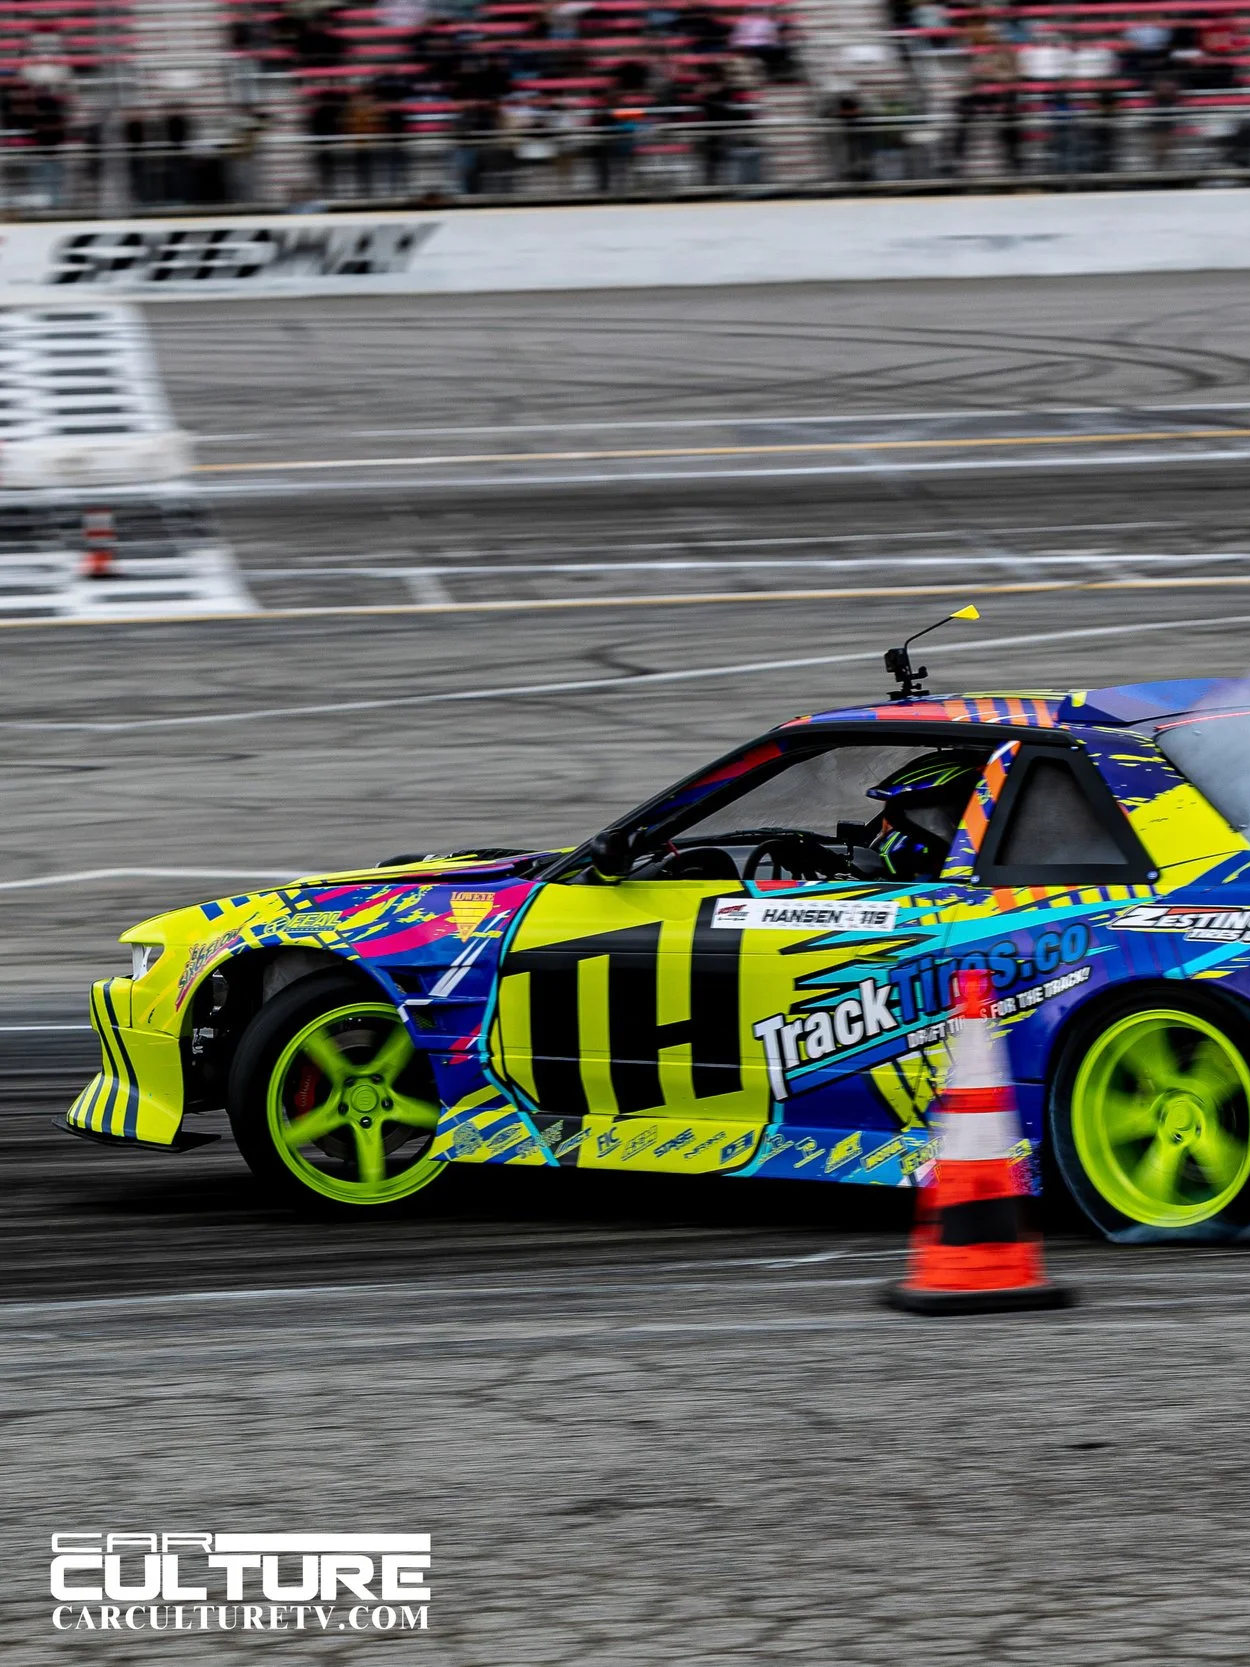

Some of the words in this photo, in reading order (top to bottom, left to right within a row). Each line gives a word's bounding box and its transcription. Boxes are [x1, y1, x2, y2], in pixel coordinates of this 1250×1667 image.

[42, 222, 443, 285] SPEEDWAY
[761, 908, 844, 924] HANSEN
[860, 910, 889, 925] 119
[1187, 929, 1240, 941] TIRES
[947, 1007, 988, 1034] TIS
[991, 997, 1017, 1019] FOR
[1016, 987, 1044, 1008] THE
